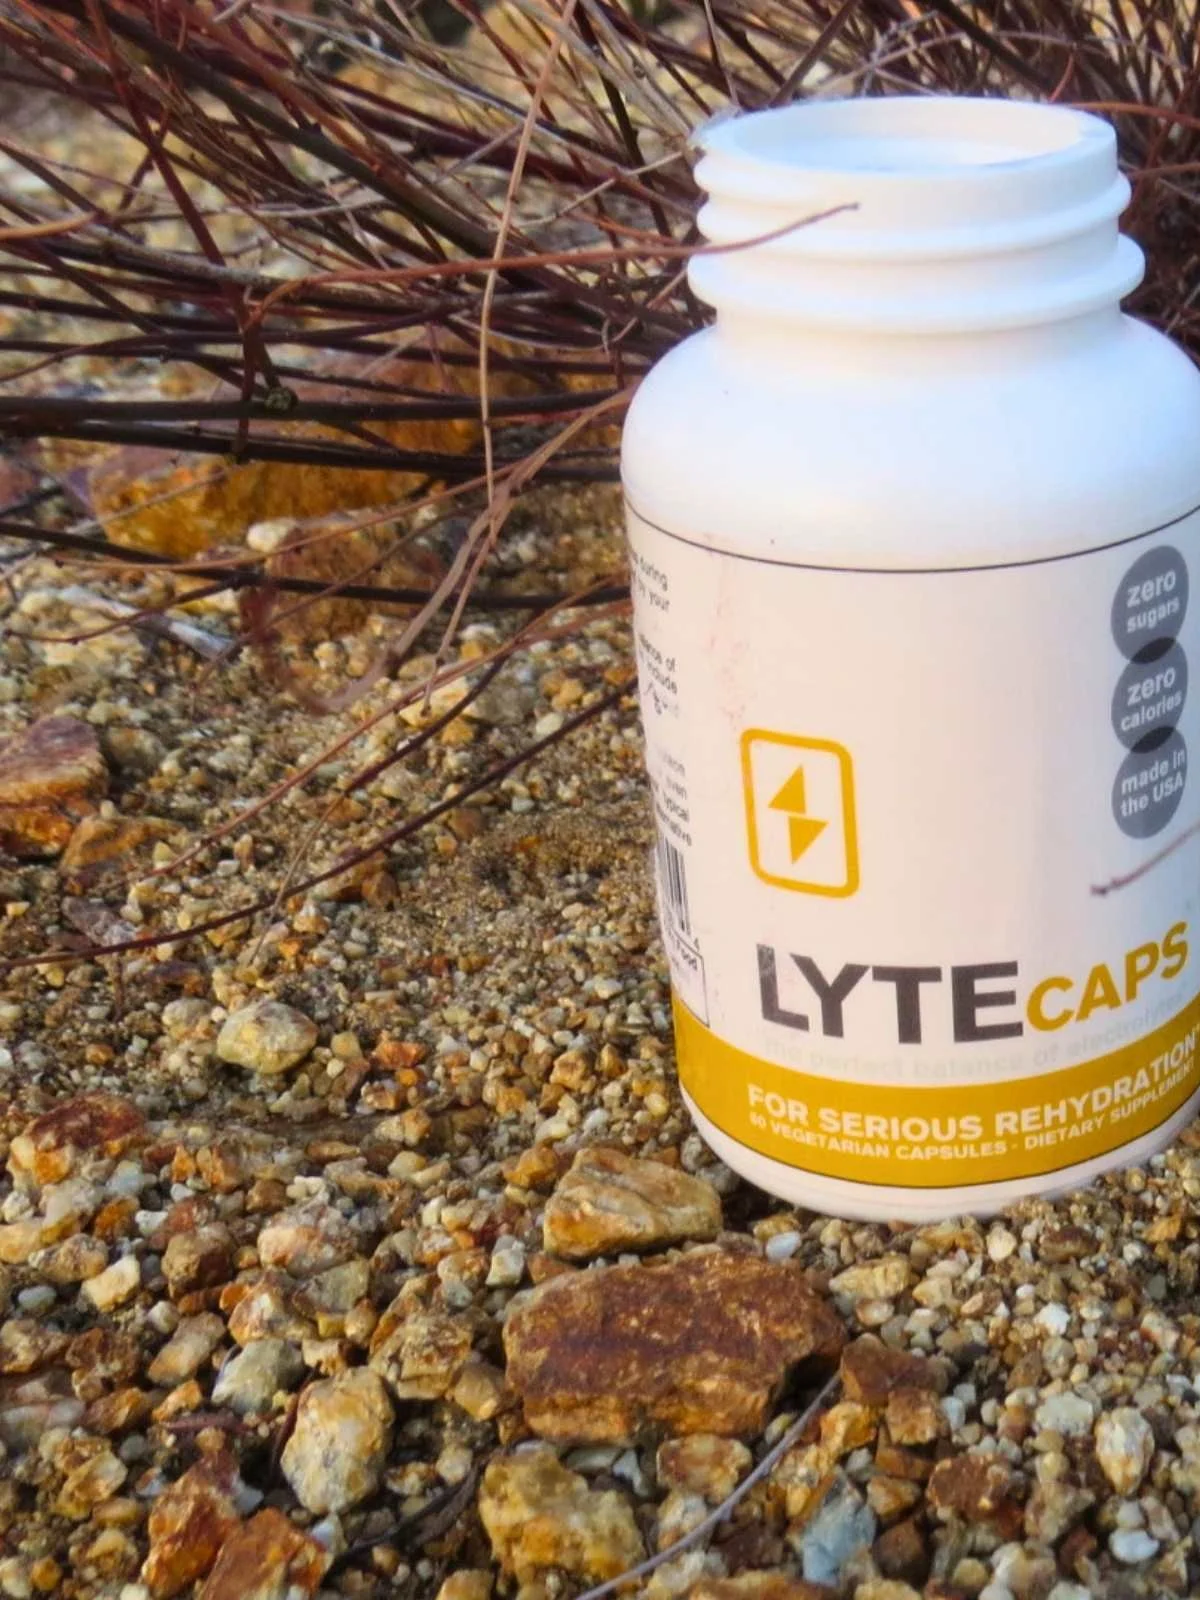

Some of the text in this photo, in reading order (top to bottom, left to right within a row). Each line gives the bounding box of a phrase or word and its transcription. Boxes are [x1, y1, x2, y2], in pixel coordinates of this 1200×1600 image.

[1126, 568, 1177, 608] zero
[1126, 596, 1181, 634] sugars
[1127, 666, 1177, 707] zero
[1120, 690, 1183, 733] calories
[1121, 748, 1187, 796] made in
[1119, 773, 1185, 818] the USA
[747, 1083, 809, 1127] FOR
[817, 1106, 984, 1143] SERIOUS
[770, 1119, 890, 1159] VEGETARIAN
[895, 1139, 1008, 1162] CAPSULES
[1024, 1115, 1106, 1151] DIETARY
[1109, 1056, 1195, 1125] SUPPLEMENT
